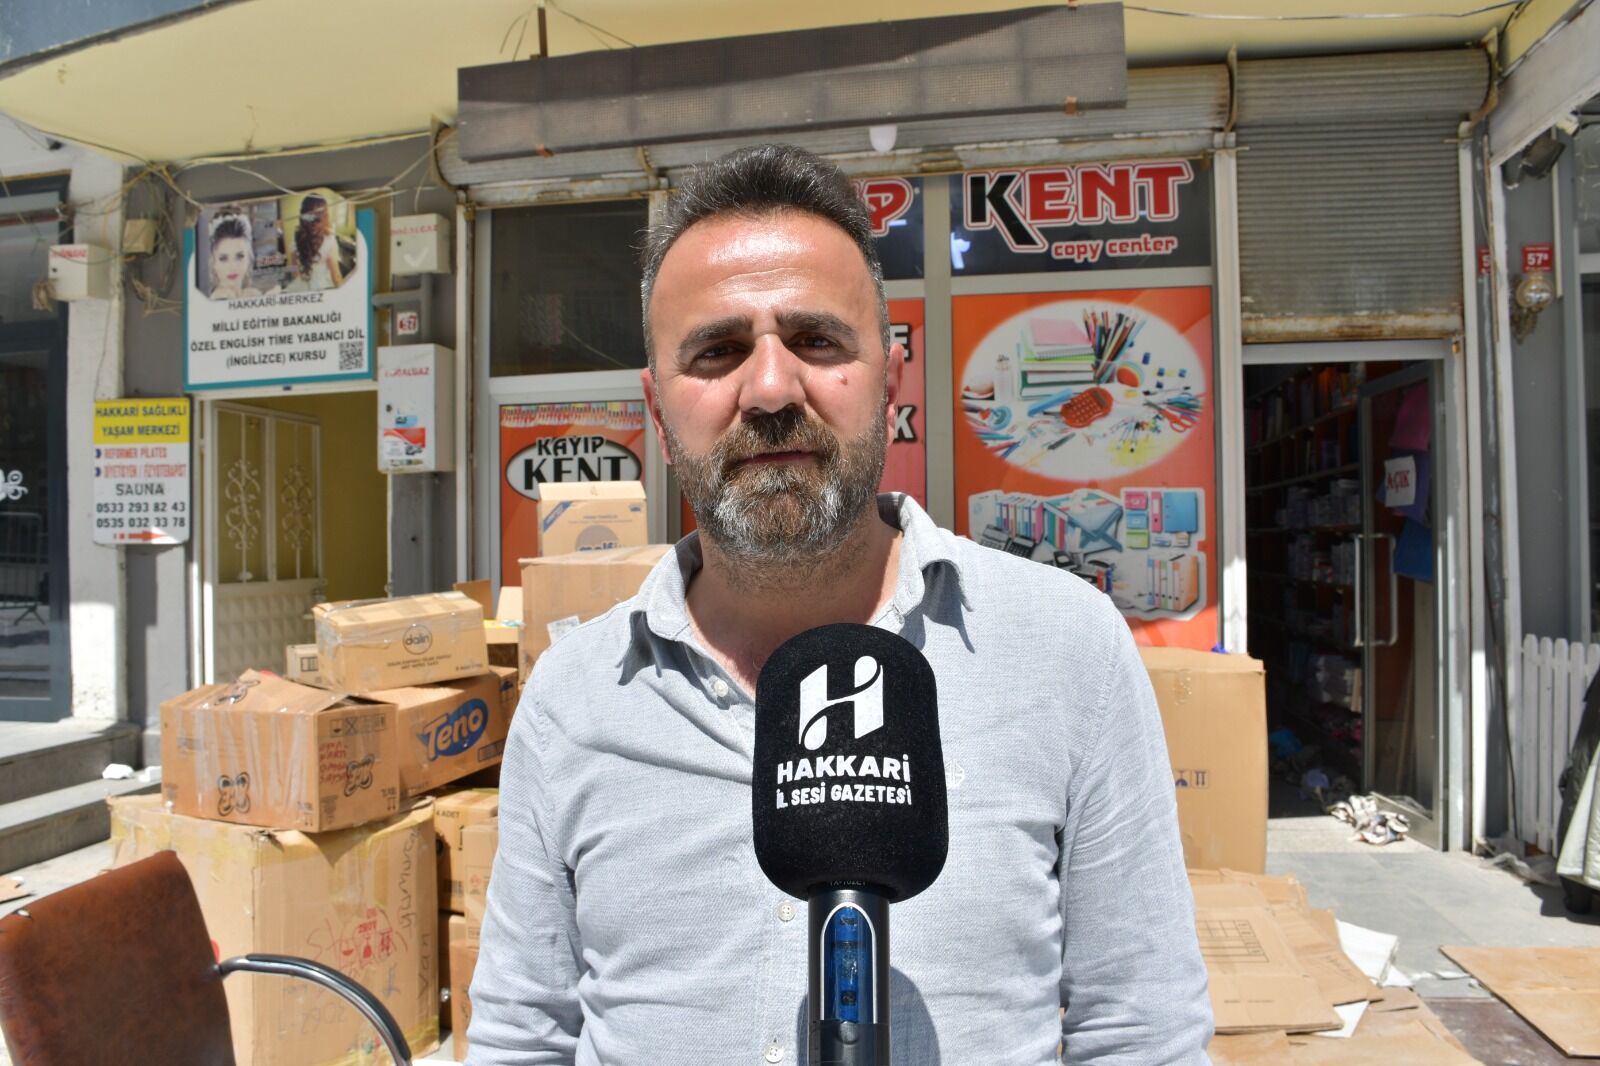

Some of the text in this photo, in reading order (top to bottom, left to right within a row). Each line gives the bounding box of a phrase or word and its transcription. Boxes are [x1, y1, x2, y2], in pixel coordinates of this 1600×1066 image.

[963, 161, 1194, 252] KENT
[1052, 234, 1178, 262] copy center
[212, 312, 342, 333] MİLLİ EĞİTİM BAKANLIĞI
[190, 339, 217, 352] ÖZEL
[297, 331, 344, 344] YABANCI
[347, 327, 366, 340] DİL
[289, 350, 327, 362] KURSU
[102, 423, 180, 438] YAŞAM MERKEZİ
[524, 456, 629, 490] KENT
[115, 483, 165, 496] SAUNA
[96, 502, 124, 513] 0533
[128, 502, 149, 513] 293
[171, 501, 186, 512] 43
[96, 518, 124, 528] 0535
[172, 517, 186, 527] 78
[423, 711, 484, 761] Teno
[777, 754, 911, 785] HAKKARİ
[791, 782, 826, 805] SESİ
[830, 784, 912, 805] GAZETESİ
